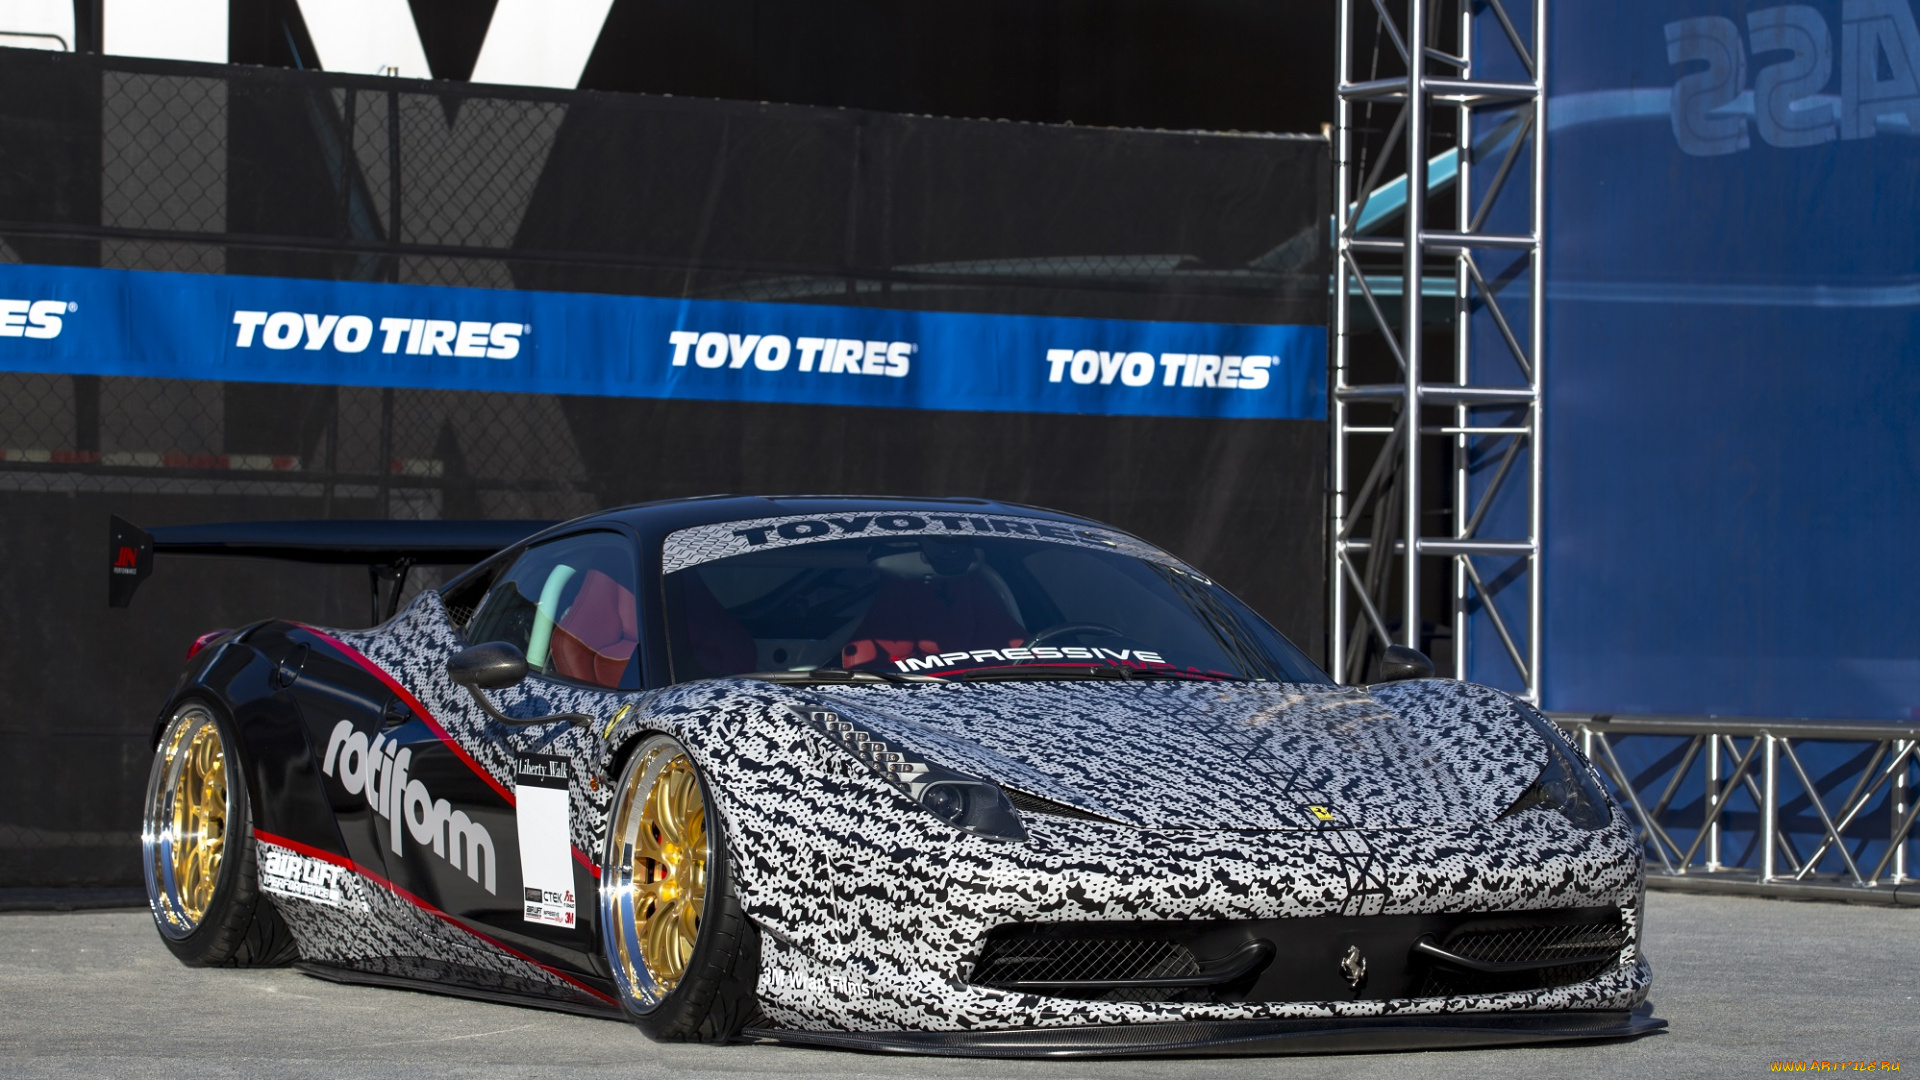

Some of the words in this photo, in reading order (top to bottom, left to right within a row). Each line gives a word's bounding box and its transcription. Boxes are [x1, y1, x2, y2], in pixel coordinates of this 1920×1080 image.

[233, 310, 373, 353] TOYO
[379, 317, 524, 360] TIRES
[669, 330, 791, 371] TOYO
[796, 337, 912, 377] TIRES
[1046, 349, 1155, 387] TOYO
[1159, 353, 1273, 390] TIRES
[893, 646, 1166, 673] IMPRESSIVE
[518, 757, 547, 782] Liberty
[549, 760, 568, 779] Walk
[322, 719, 497, 896] rotiform
[543, 890, 562, 904] CTEK
[564, 911, 574, 925] 3M
[763, 967, 786, 987] 3M
[789, 970, 826, 994] Wrap
[829, 975, 871, 997] Films
